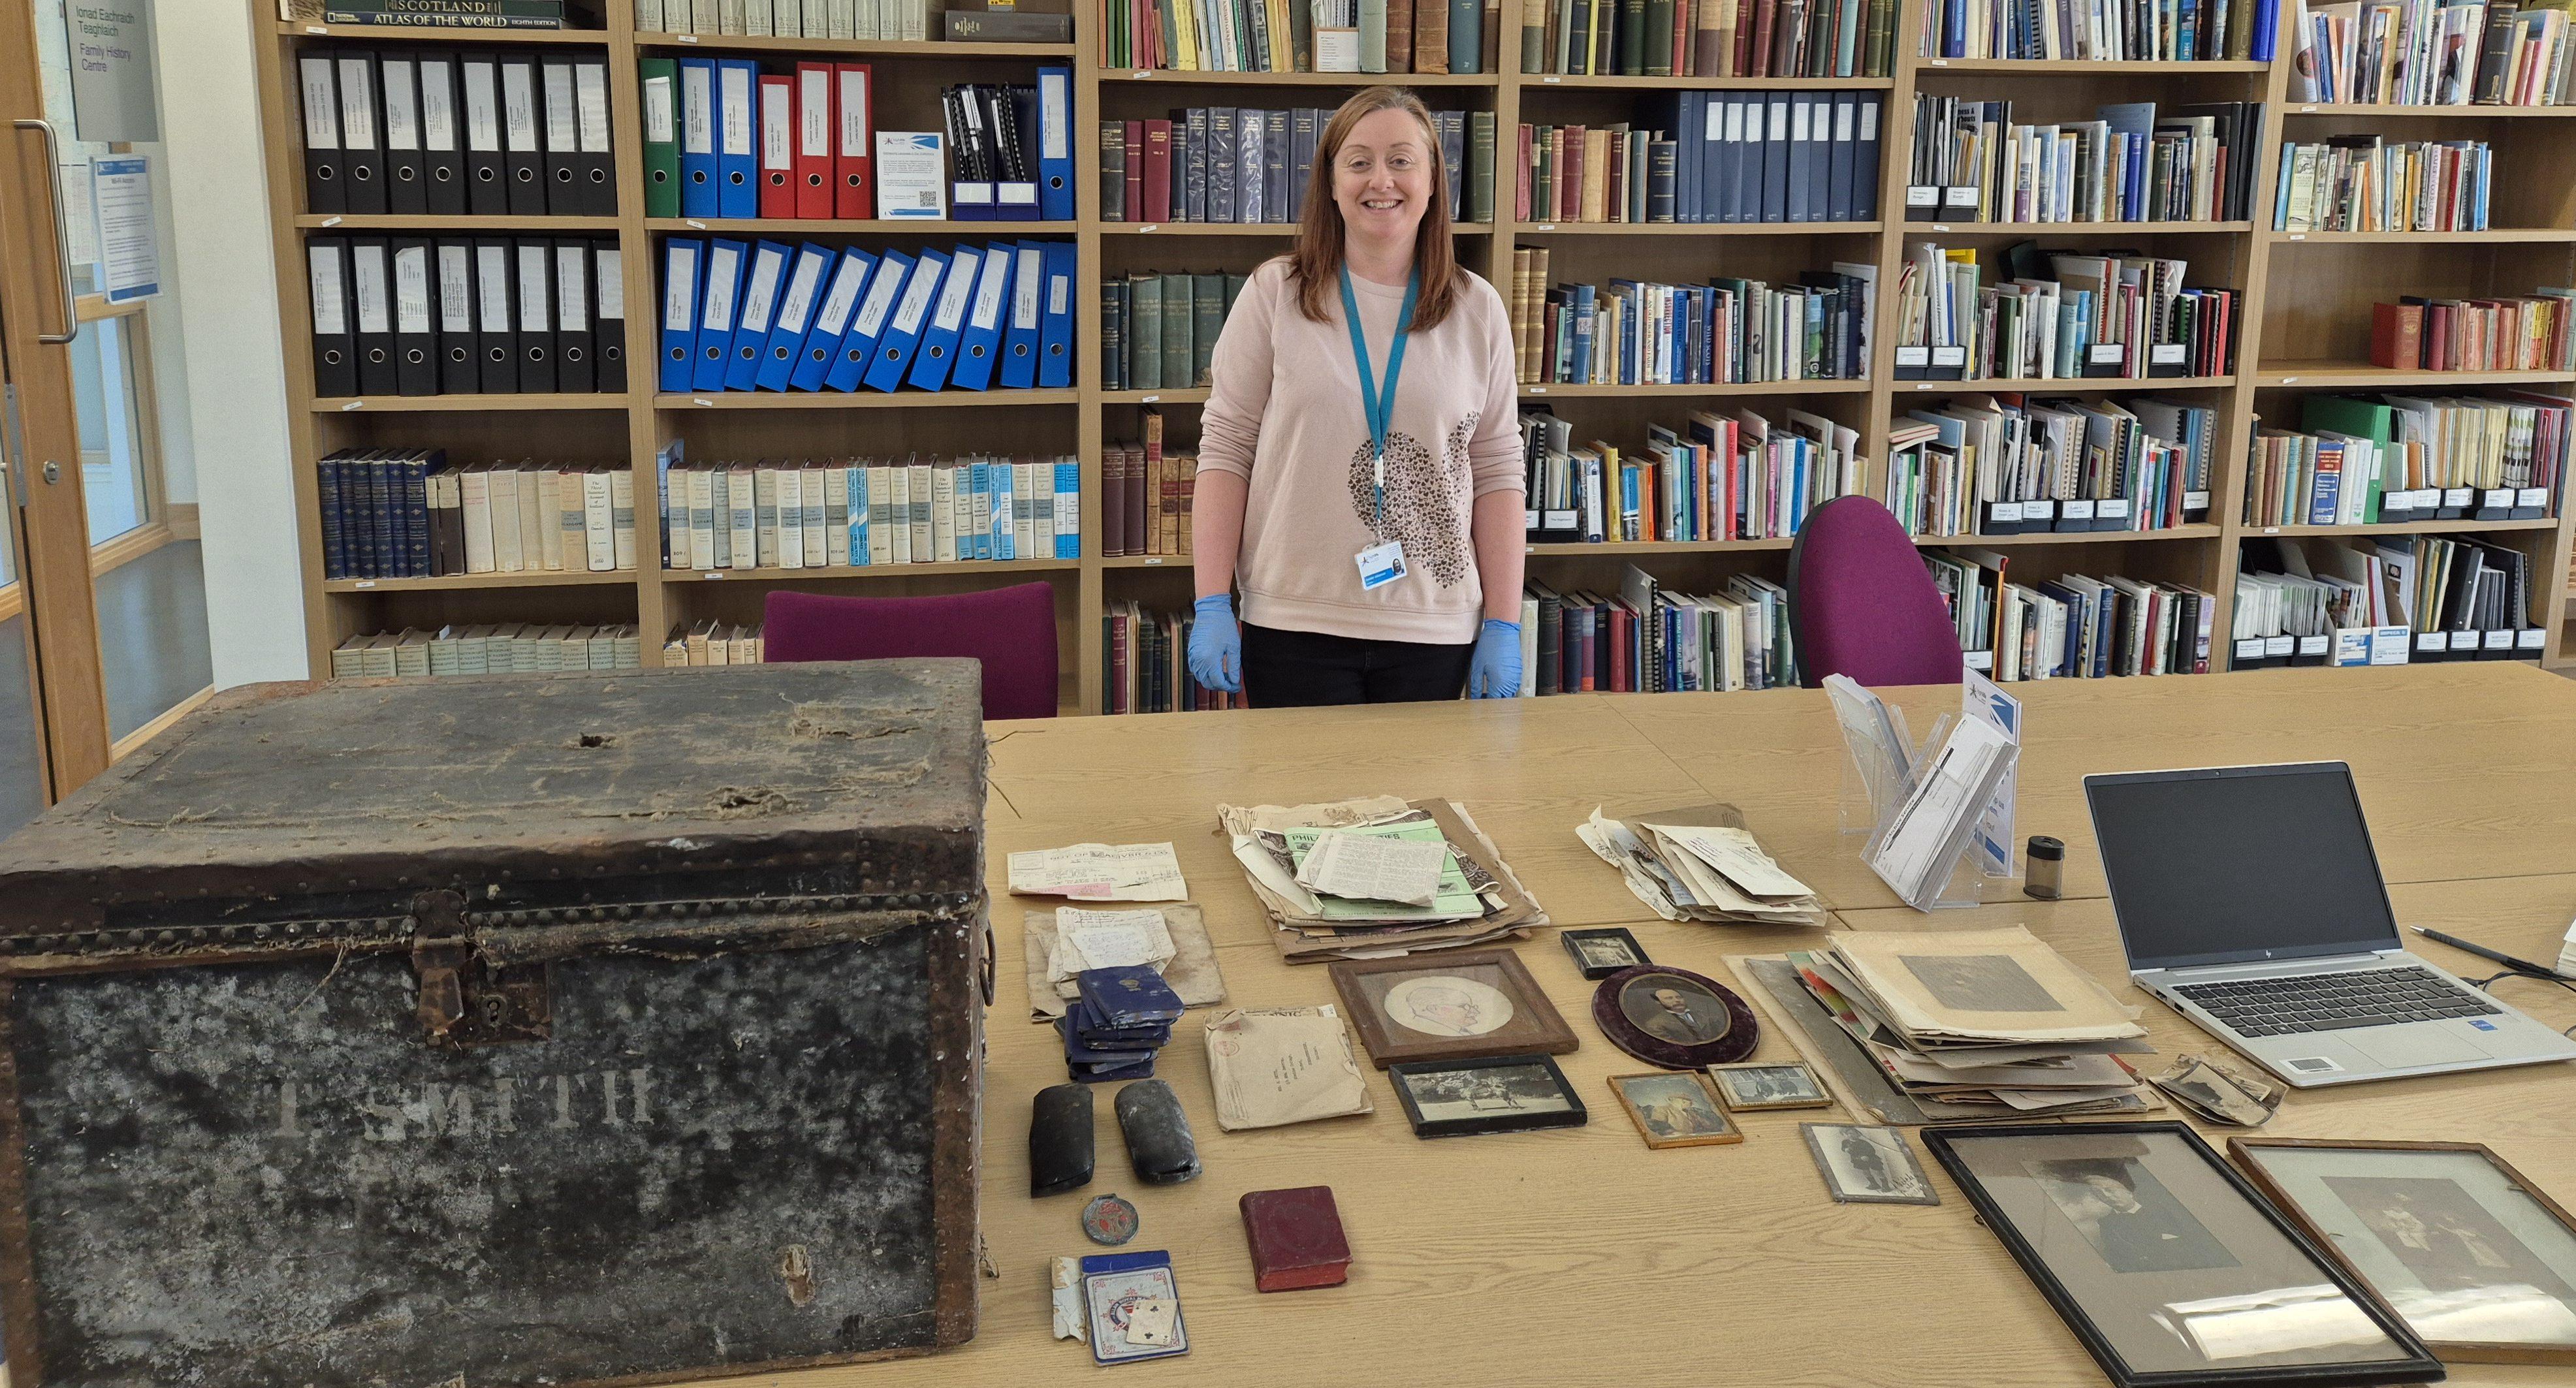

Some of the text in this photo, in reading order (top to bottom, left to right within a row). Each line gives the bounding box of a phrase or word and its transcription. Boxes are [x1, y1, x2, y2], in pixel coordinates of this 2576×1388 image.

[76, 6, 97, 20] Ionad
[398, 0, 485, 12] SCOTLAND
[374, 14, 507, 27] ATLAS OF THE WORLD
[80, 43, 131, 62] Family History
[82, 59, 107, 72] Centre
[1566, 300, 1574, 324] ALBA
[1663, 297, 1673, 335] INSURRECTION
[1888, 817, 1902, 838] Archive
